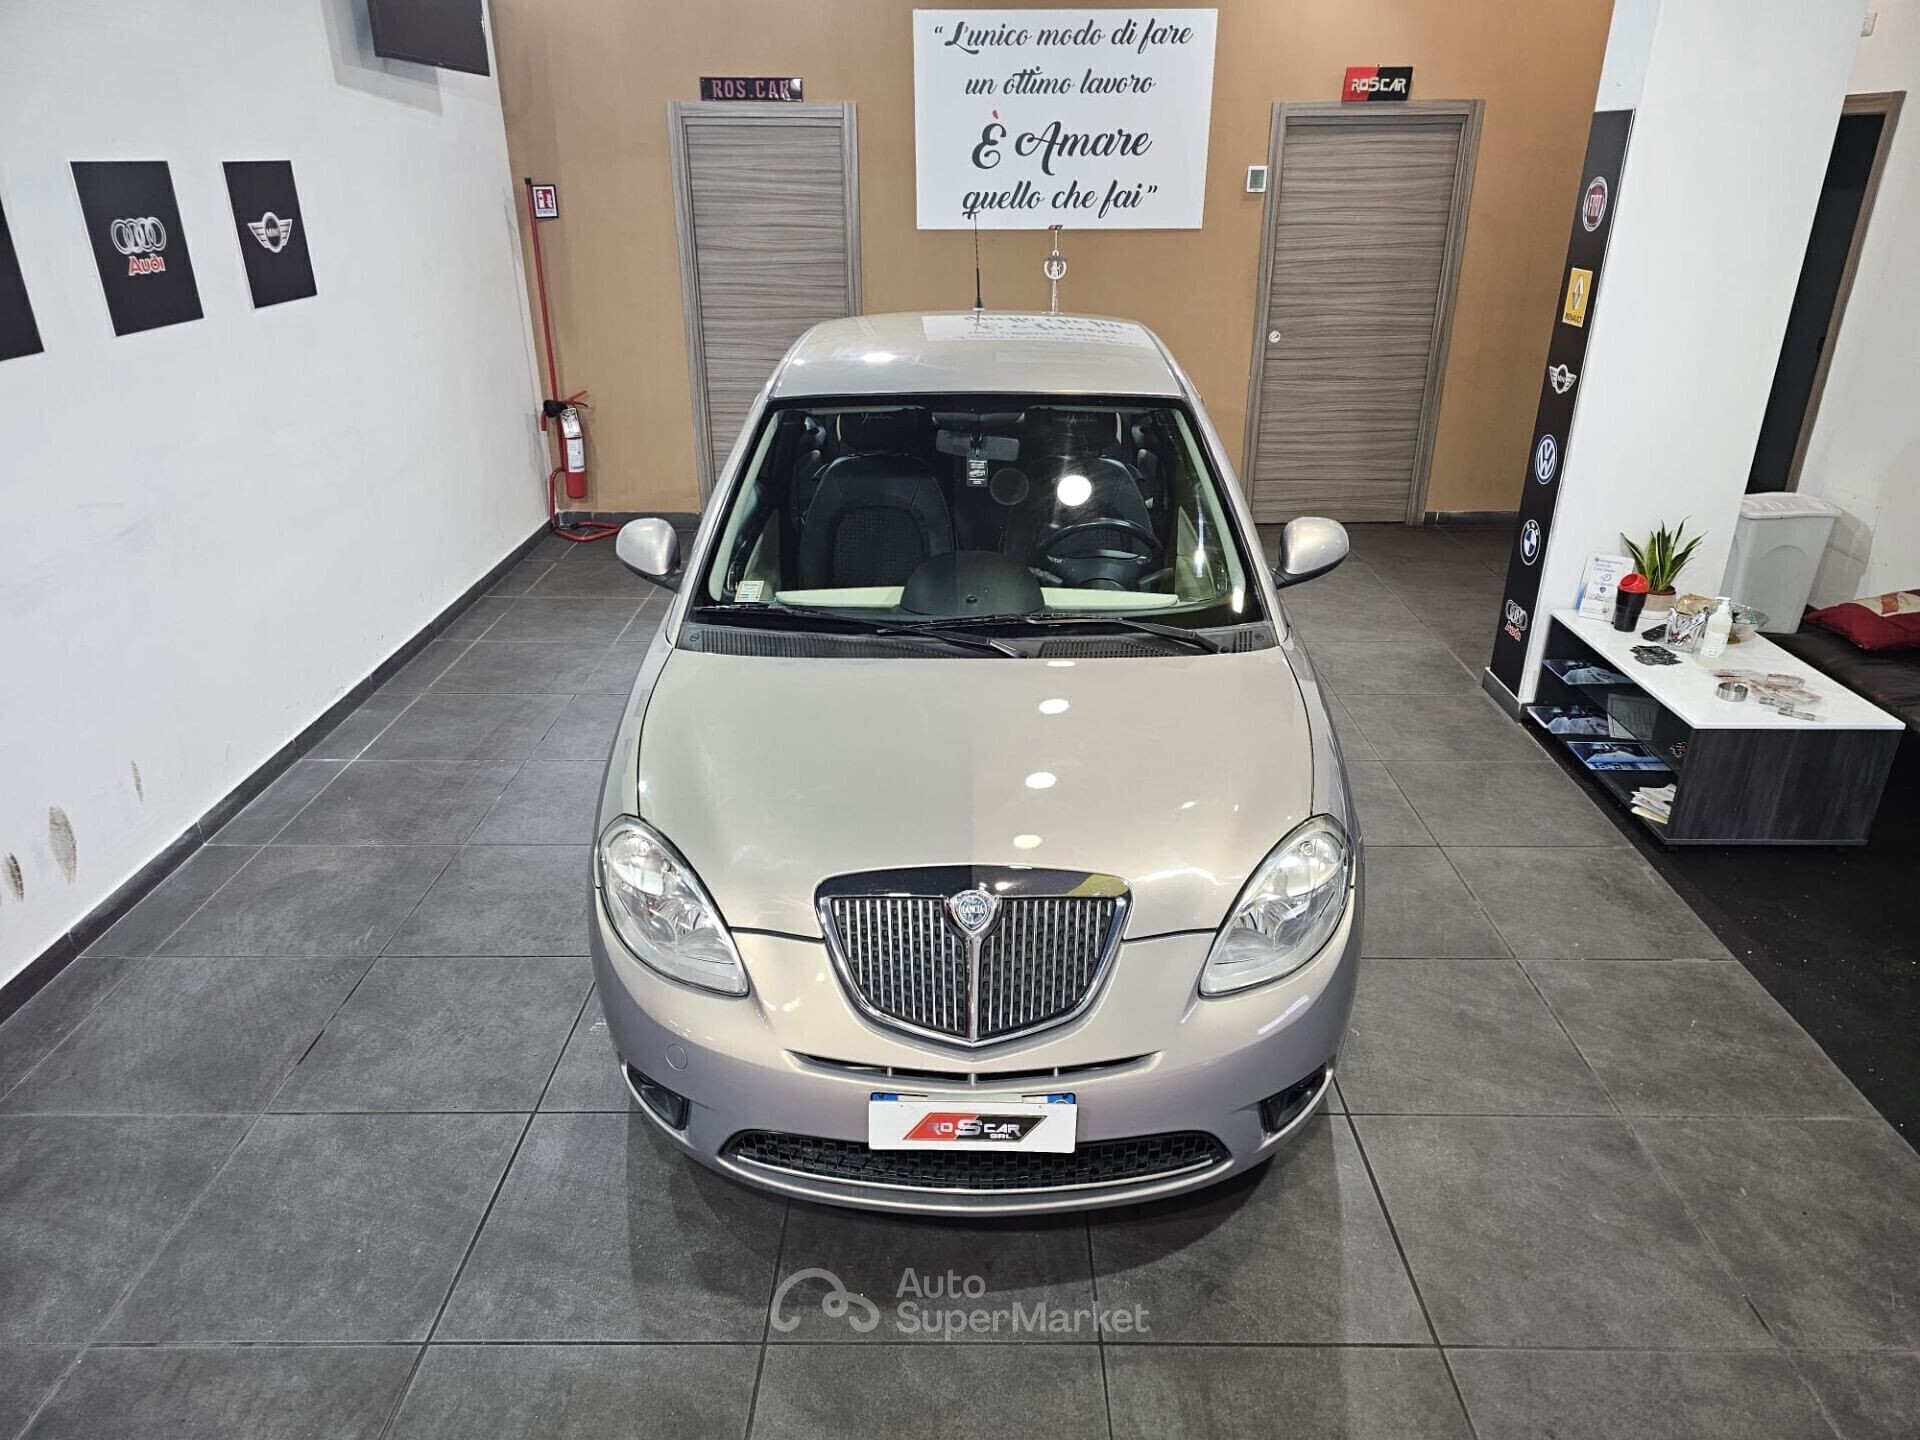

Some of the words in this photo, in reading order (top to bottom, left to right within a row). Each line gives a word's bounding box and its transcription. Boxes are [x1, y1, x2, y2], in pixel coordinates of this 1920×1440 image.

[1036, 19, 1105, 46] modo
[1111, 19, 1137, 45] di
[1137, 18, 1193, 54] fare
[964, 77, 997, 95] un
[1003, 66, 1075, 95] ottimo
[1079, 68, 1156, 94] lavoro
[1351, 77, 1406, 93] ROSCAR
[1014, 120, 1153, 176] Amare
[962, 180, 1045, 220] quello
[1051, 179, 1098, 209] che
[128, 253, 166, 277] Audi
